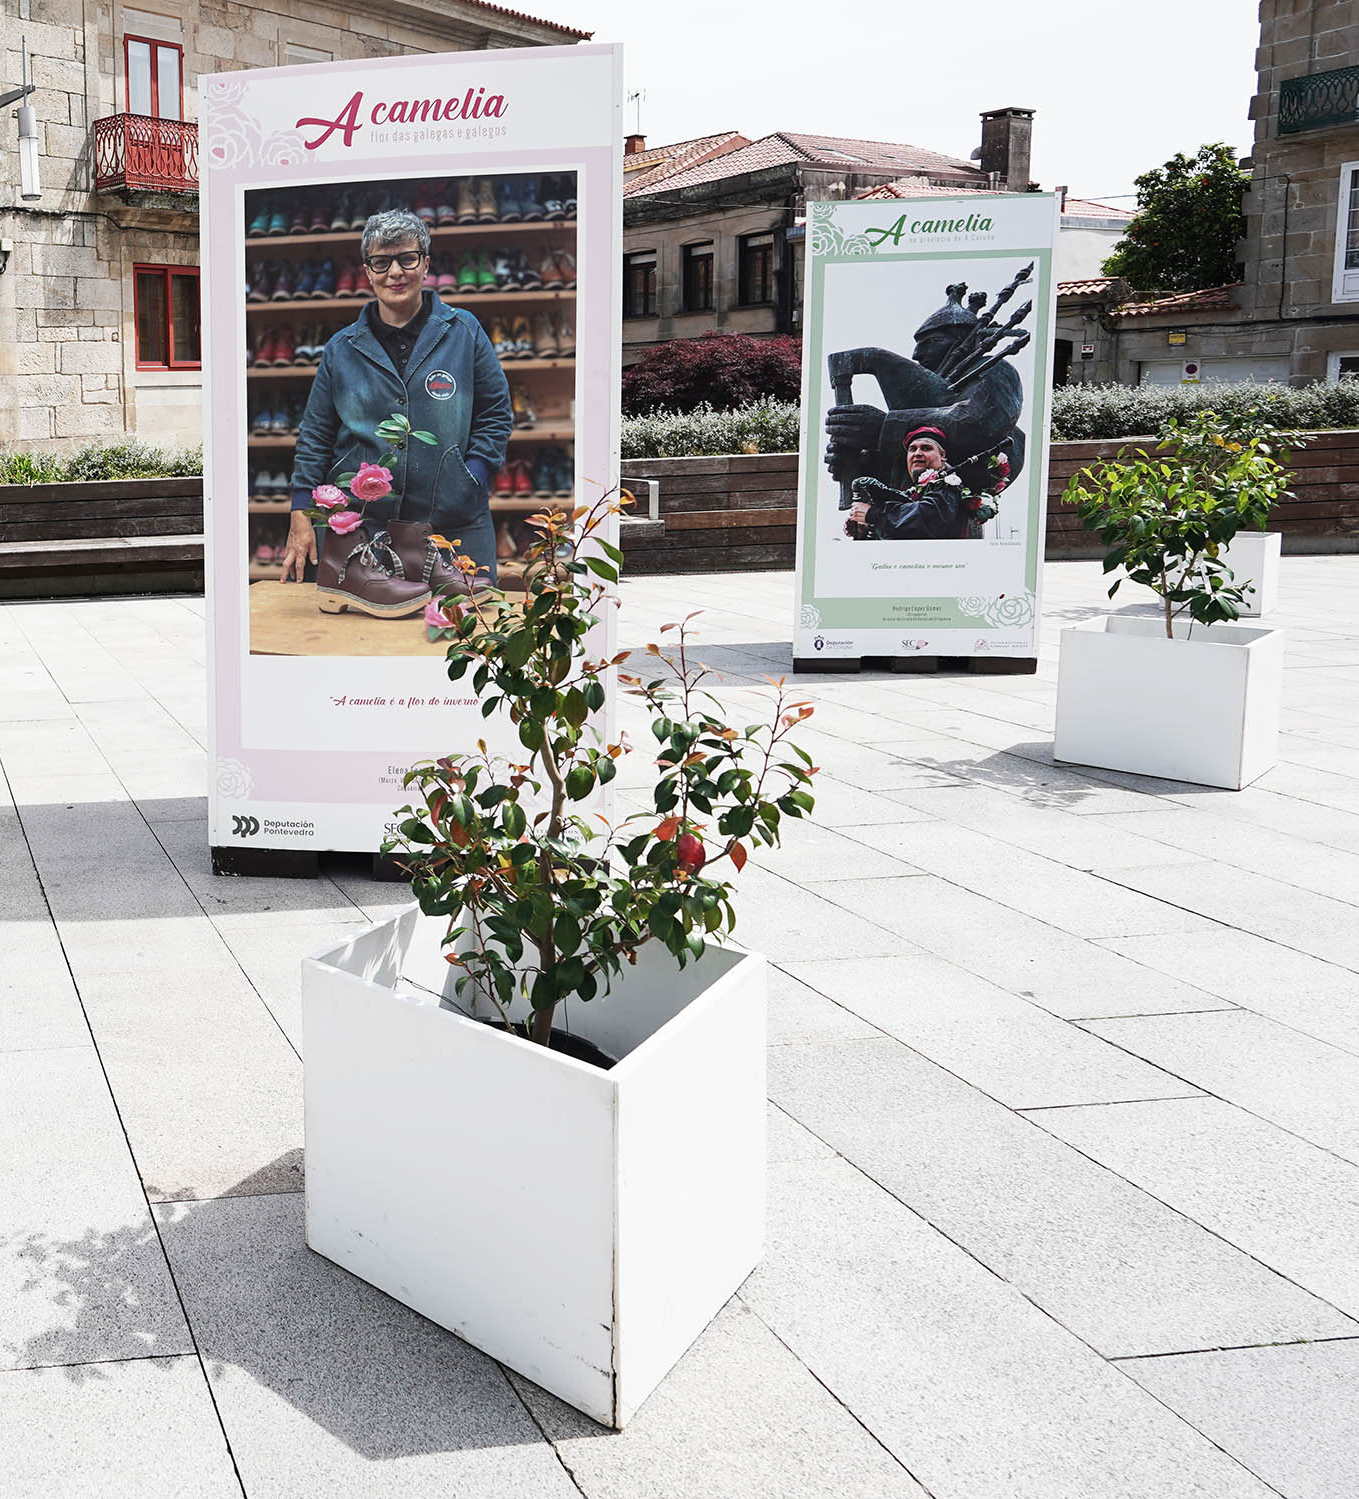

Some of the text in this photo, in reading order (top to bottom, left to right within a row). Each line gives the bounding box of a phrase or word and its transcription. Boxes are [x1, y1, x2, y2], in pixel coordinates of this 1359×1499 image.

[296, 87, 509, 149] A camelia
[370, 131, 389, 143] flor
[392, 128, 411, 141] das
[413, 127, 455, 143] galegas
[465, 125, 507, 140] galegos
[864, 213, 995, 247] A camelia
[349, 696, 386, 706] camelia
[398, 698, 405, 706] a
[407, 696, 425, 709] flor
[428, 696, 440, 706] do
[263, 818, 315, 828] Deputación
[263, 828, 315, 836] Pontevedra
